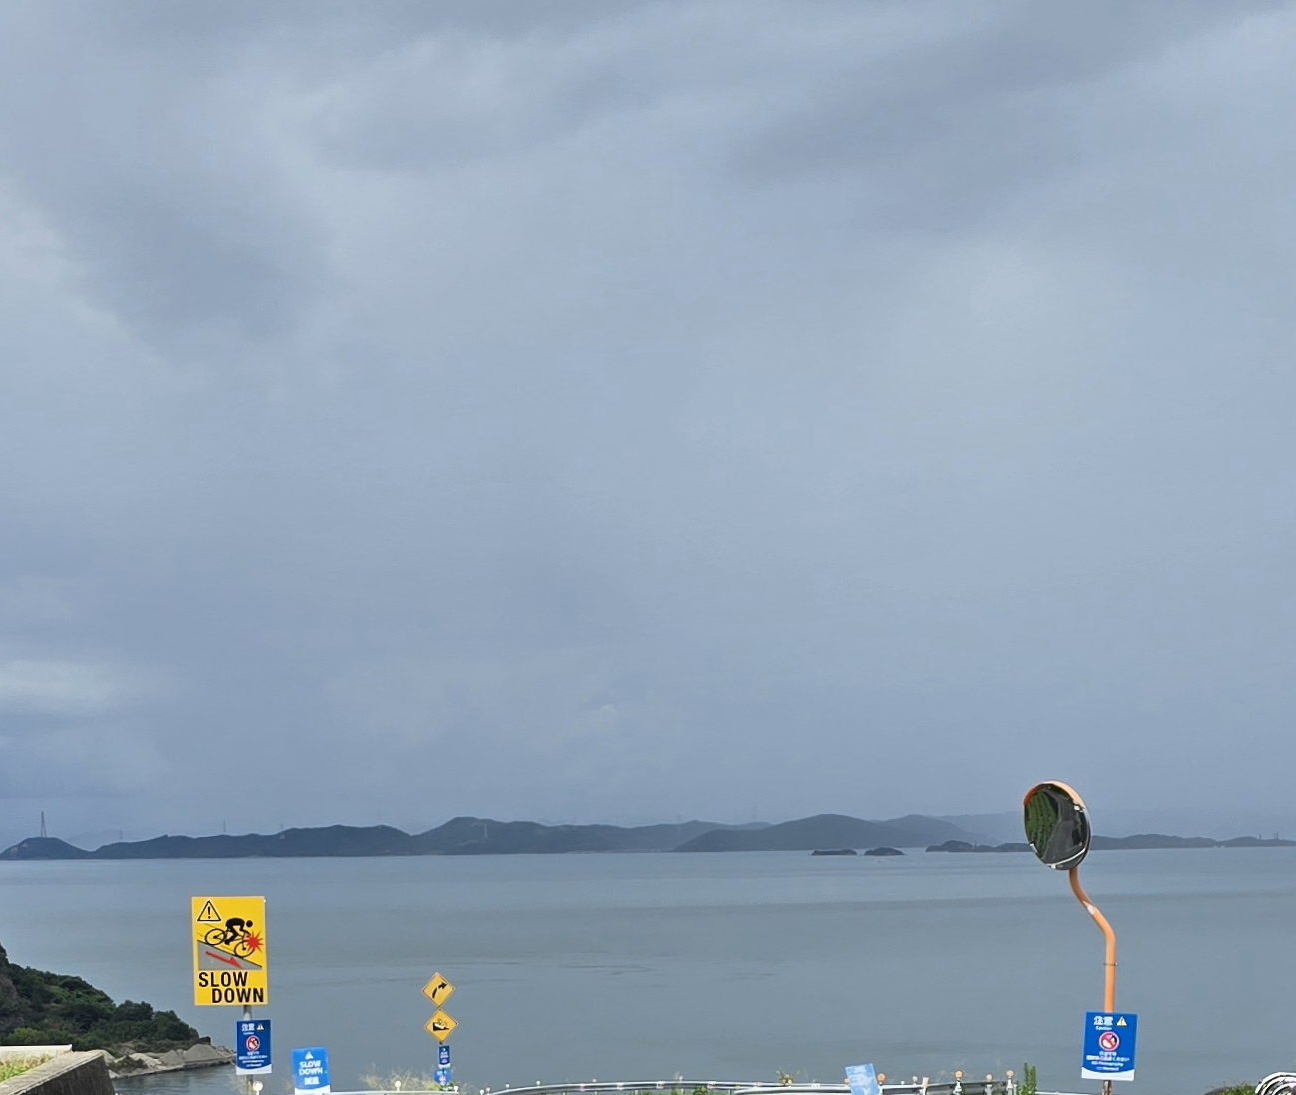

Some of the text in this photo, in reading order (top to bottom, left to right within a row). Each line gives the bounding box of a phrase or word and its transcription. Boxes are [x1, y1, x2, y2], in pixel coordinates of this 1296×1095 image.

[198, 971, 248, 988] SLOW
[211, 987, 264, 1004] DOWN
[299, 1060, 321, 1069] SLOW
[298, 1067, 324, 1077] DOWN
